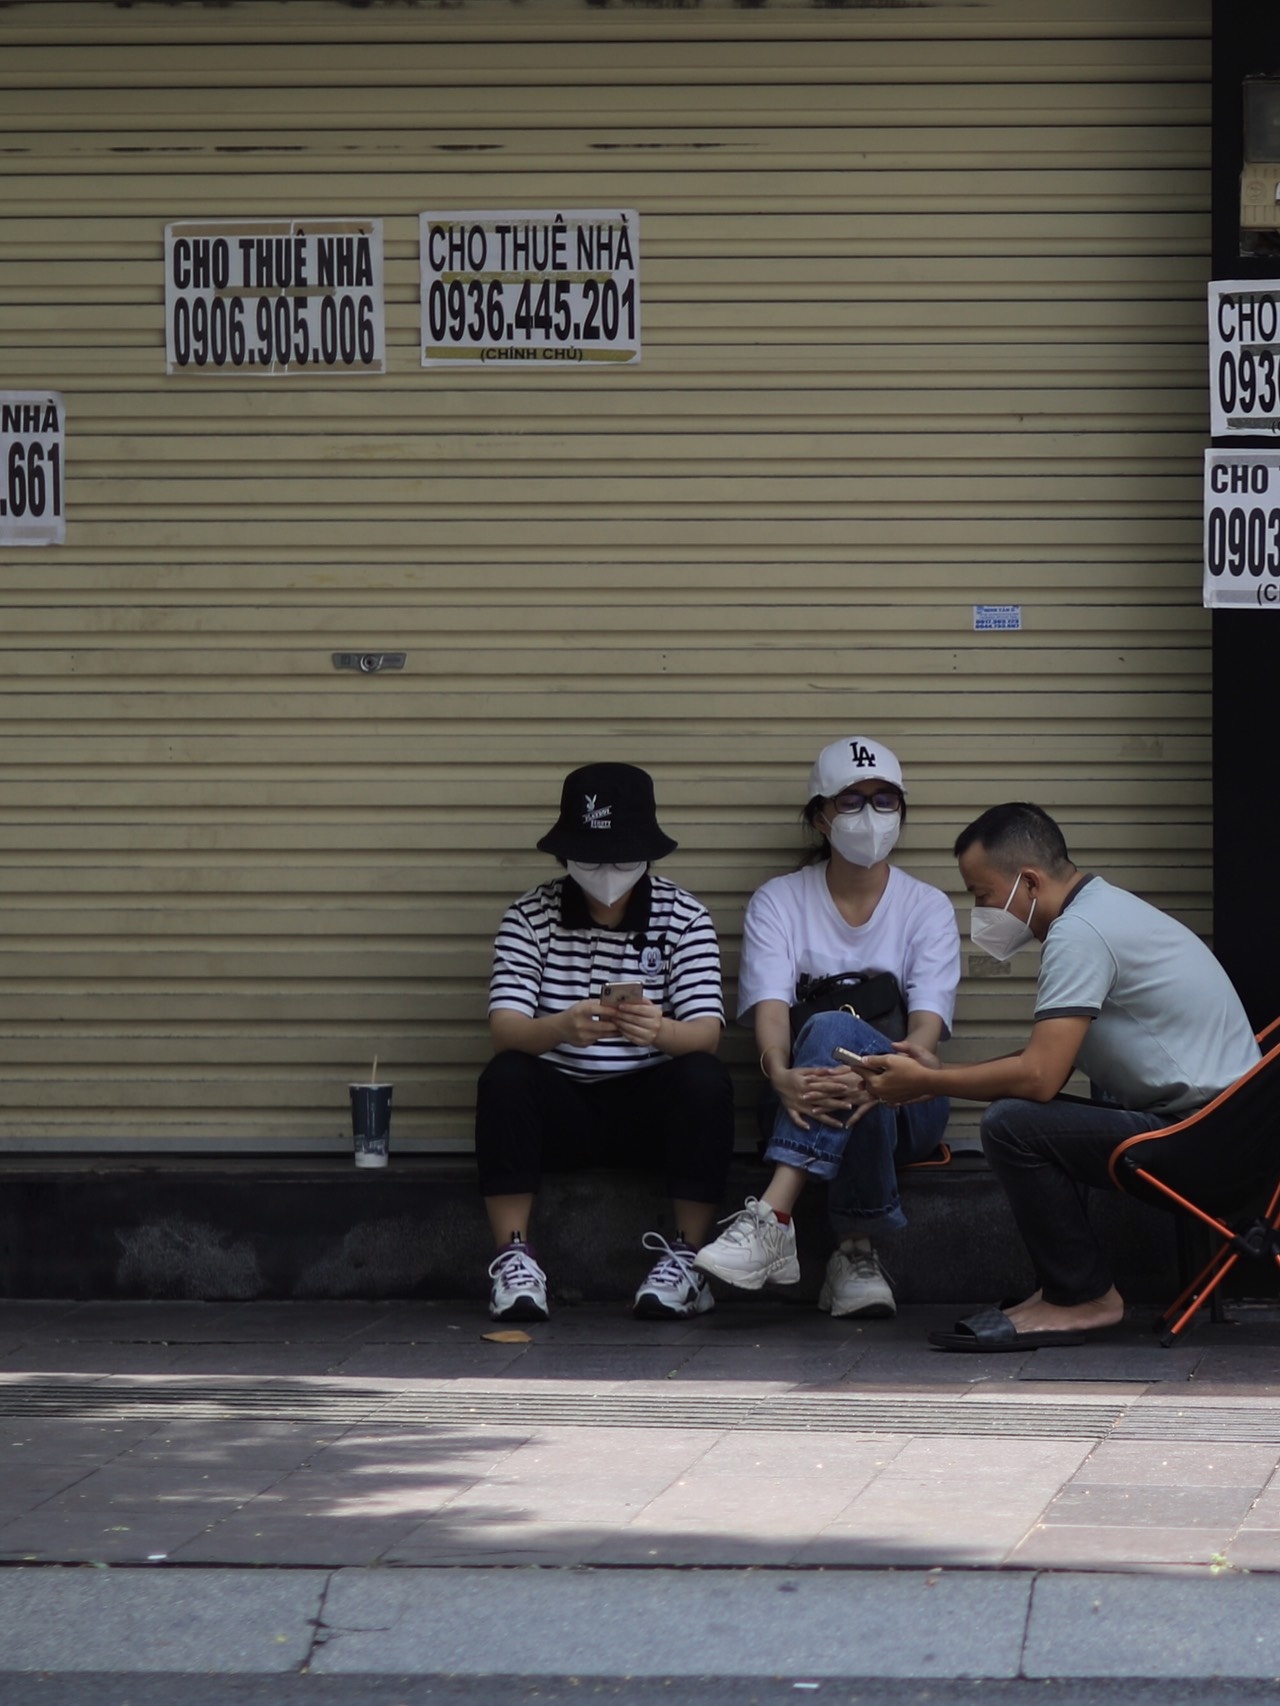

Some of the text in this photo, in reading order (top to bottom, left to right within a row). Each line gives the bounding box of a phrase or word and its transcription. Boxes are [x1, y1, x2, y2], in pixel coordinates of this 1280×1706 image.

[173, 228, 373, 289] CHO THUÊ NHÀ
[429, 213, 634, 272] CHO THUÊ NHÀ
[173, 294, 374, 367] 0906.905.006
[429, 278, 635, 341] 0936.445.201
[1218, 294, 1278, 343] CHO
[2, 398, 59, 433] NHÀ
[1210, 464, 1269, 494] CHO
[849, 741, 876, 768] LA
